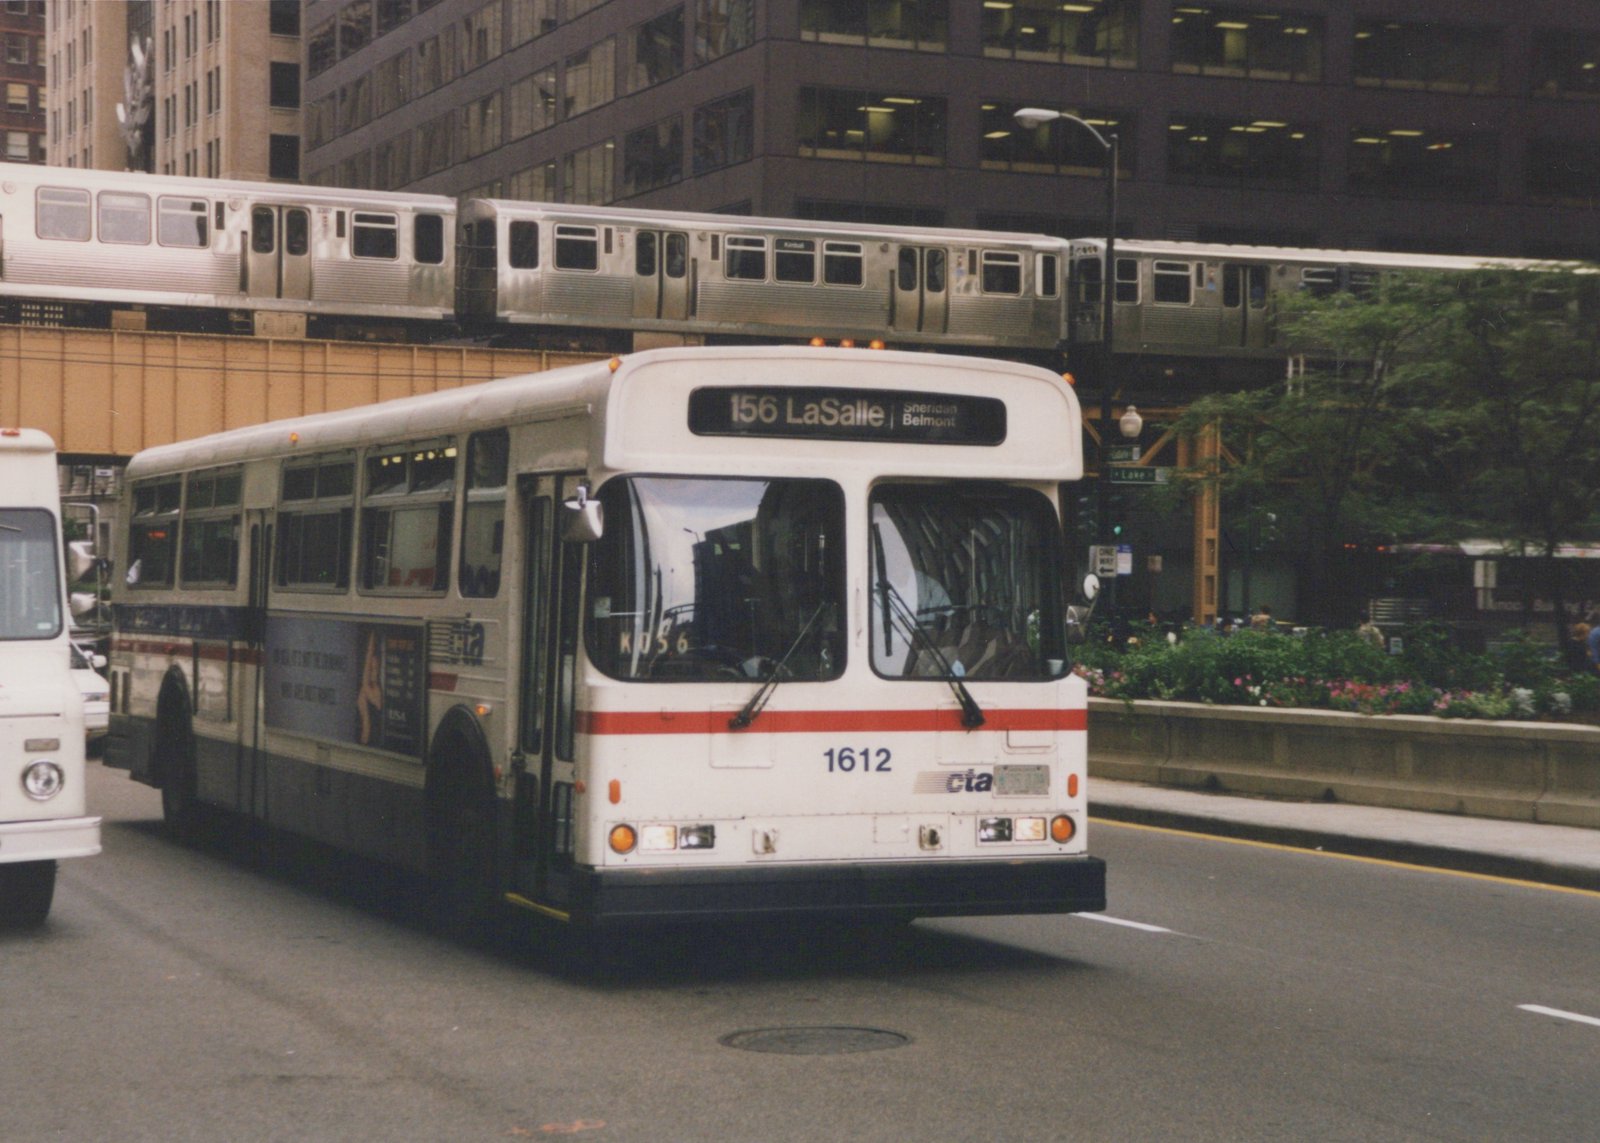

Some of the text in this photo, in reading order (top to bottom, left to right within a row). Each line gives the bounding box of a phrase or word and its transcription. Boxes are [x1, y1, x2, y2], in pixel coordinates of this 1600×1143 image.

[731, 395, 885, 427] 156 LaSalle
[903, 413, 956, 427] Belmont
[823, 747, 892, 772] 1612
[945, 769, 993, 793] cta
